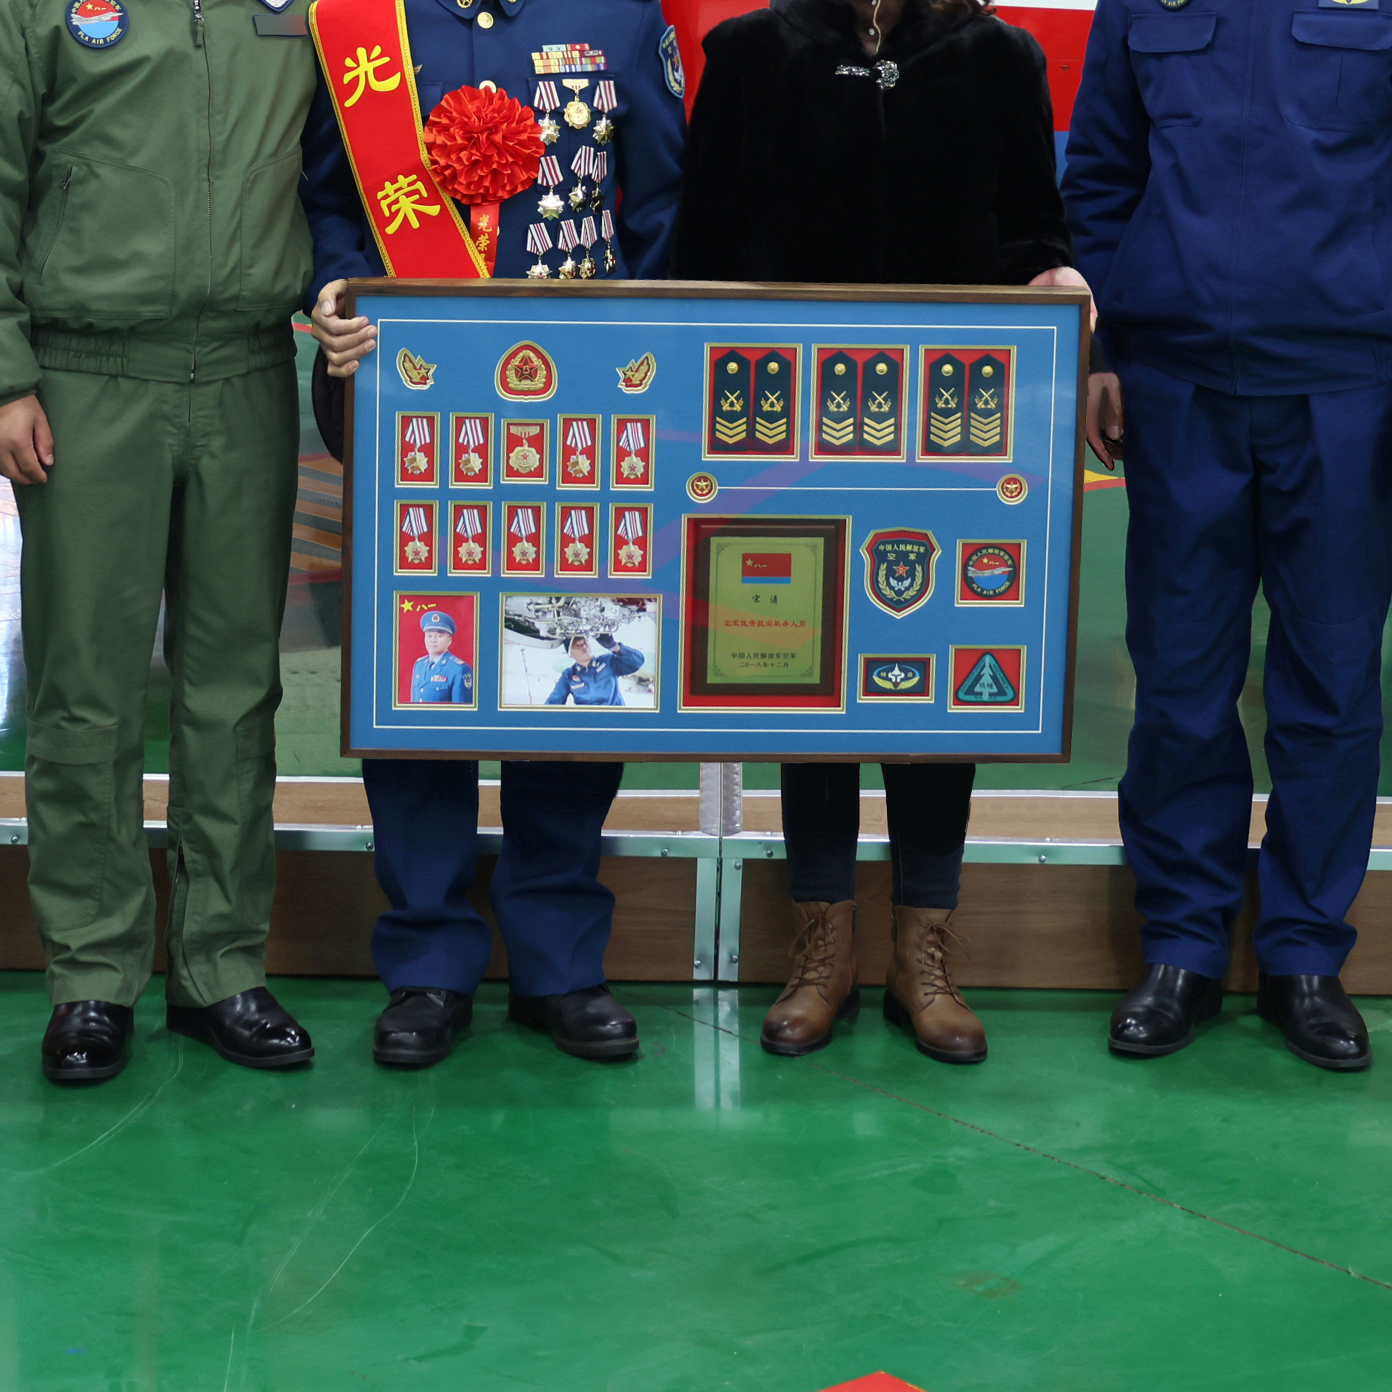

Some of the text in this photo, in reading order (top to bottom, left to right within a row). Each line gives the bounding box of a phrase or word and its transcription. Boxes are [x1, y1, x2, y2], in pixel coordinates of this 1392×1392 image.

[77, 31, 89, 42] PLA
[106, 27, 123, 43] FORCE
[878, 544, 925, 553] 中国人民解放军
[972, 583, 981, 592] PLA
[416, 603, 437, 612] 八一
